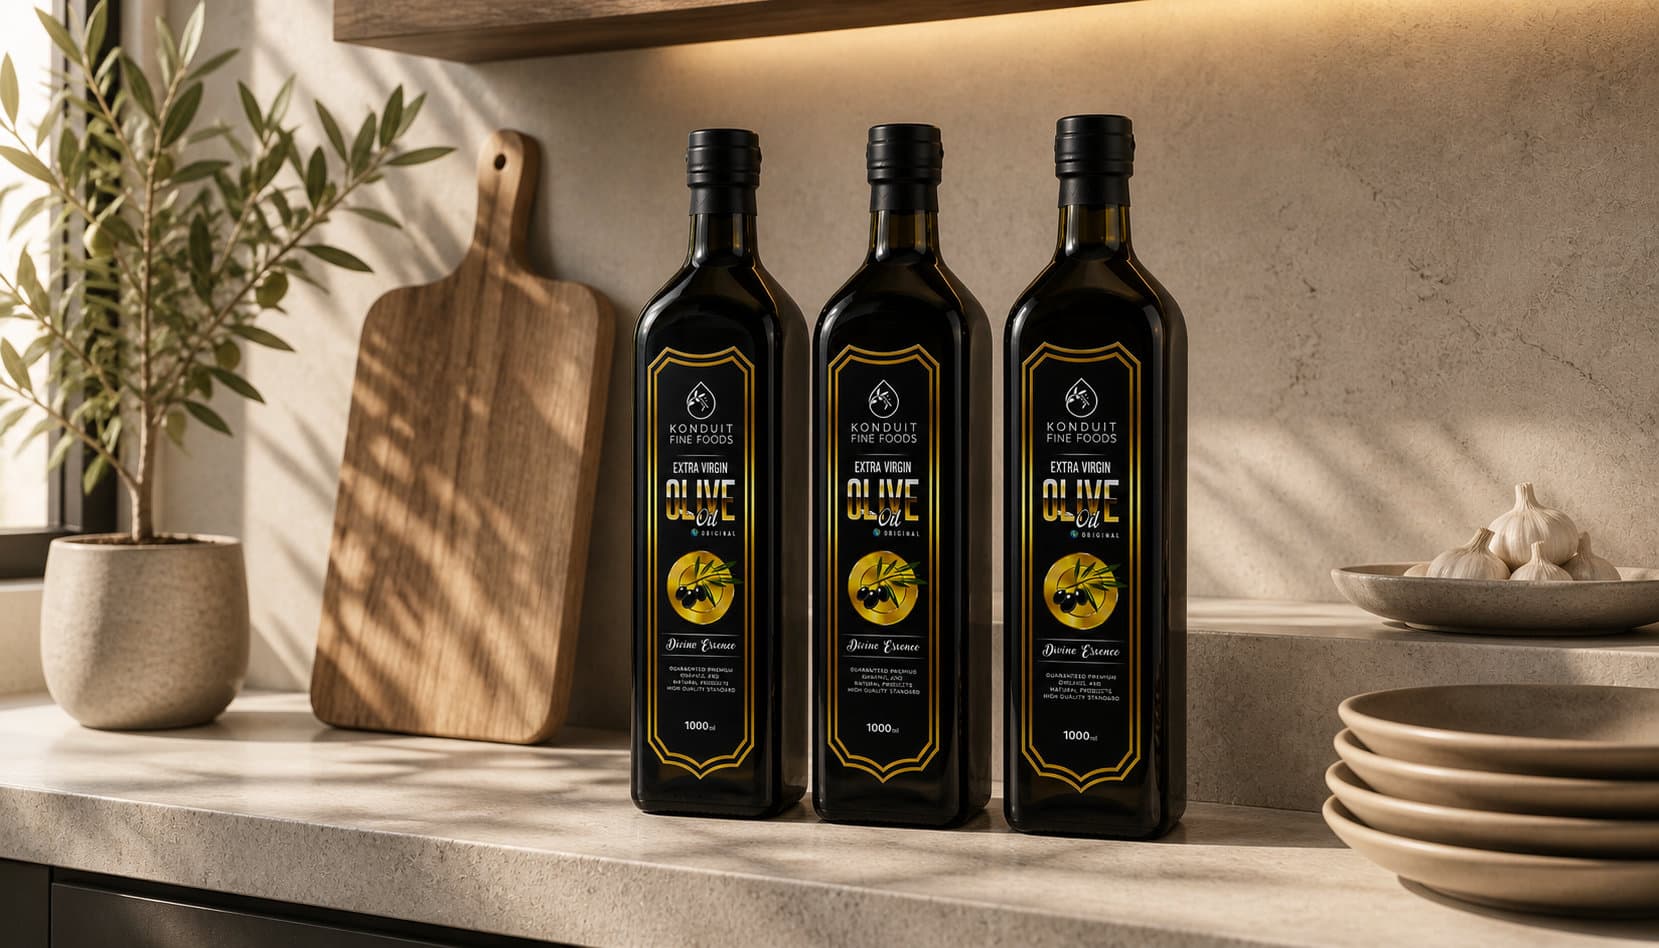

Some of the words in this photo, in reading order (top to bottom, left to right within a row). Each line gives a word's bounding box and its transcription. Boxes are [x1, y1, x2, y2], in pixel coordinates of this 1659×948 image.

[670, 424, 733, 434] KONDUIT
[851, 422, 917, 433] KONDUIT
[1046, 422, 1117, 432] KONDUIT
[669, 435, 692, 444] FINE
[696, 435, 734, 444] FOODS
[850, 434, 875, 443] FINE
[880, 434, 917, 443] FOODS
[1046, 433, 1072, 443] FINE
[1076, 433, 1118, 443] FOODS
[673, 461, 699, 474] EXTRA
[701, 461, 728, 474] VIRGIN
[854, 461, 881, 473] EXTRA
[884, 461, 912, 473] VIRGIN
[1050, 461, 1079, 473] EXTRA
[1081, 461, 1111, 473] VIRGIN
[666, 479, 736, 521] OLIVE
[847, 478, 919, 521] OLIVE
[1043, 479, 1119, 522] OLIVE
[696, 508, 719, 527] Oil
[878, 508, 901, 527] Oil
[1076, 509, 1100, 528] Oil
[665, 637, 697, 651] Divine
[846, 638, 879, 652] Divine
[1042, 643, 1077, 657] Divine
